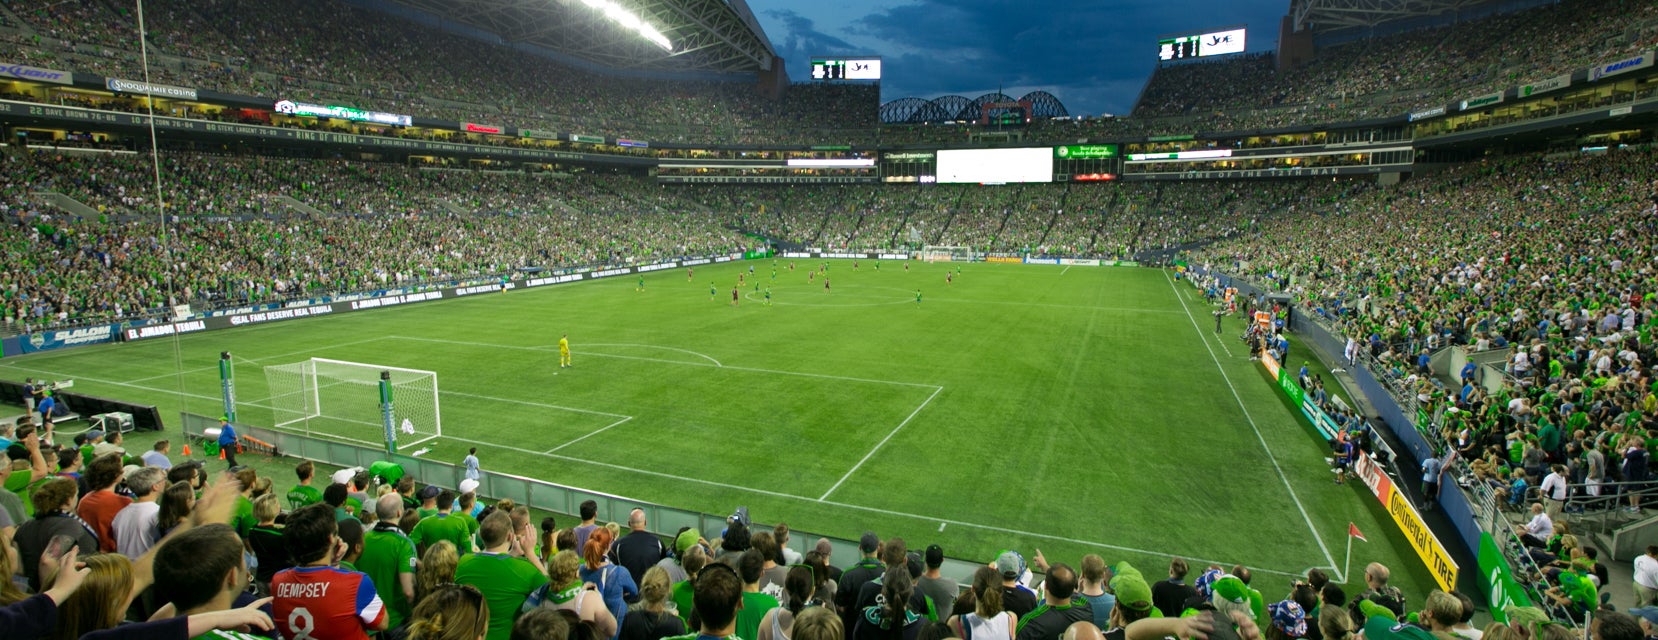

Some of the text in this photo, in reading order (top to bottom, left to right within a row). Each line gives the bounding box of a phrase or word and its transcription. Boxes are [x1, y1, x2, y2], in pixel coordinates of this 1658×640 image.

[114, 80, 166, 94] SNOQUALMIE
[29, 106, 42, 114] 22
[45, 108, 63, 117] DAVE
[65, 110, 89, 119] BROWN
[296, 130, 357, 144] RING OF HONOR
[250, 312, 266, 322] FANS
[266, 309, 294, 320] DESERVE
[294, 307, 309, 316] REAL
[309, 304, 332, 315] TEQUILA
[55, 325, 111, 341] SLALOM
[128, 328, 140, 340] EL
[175, 320, 206, 332] TEQUILA
[1391, 491, 1454, 589] Continental TIRE
[277, 581, 330, 598] DEMPSEY
[288, 607, 318, 640] 8
